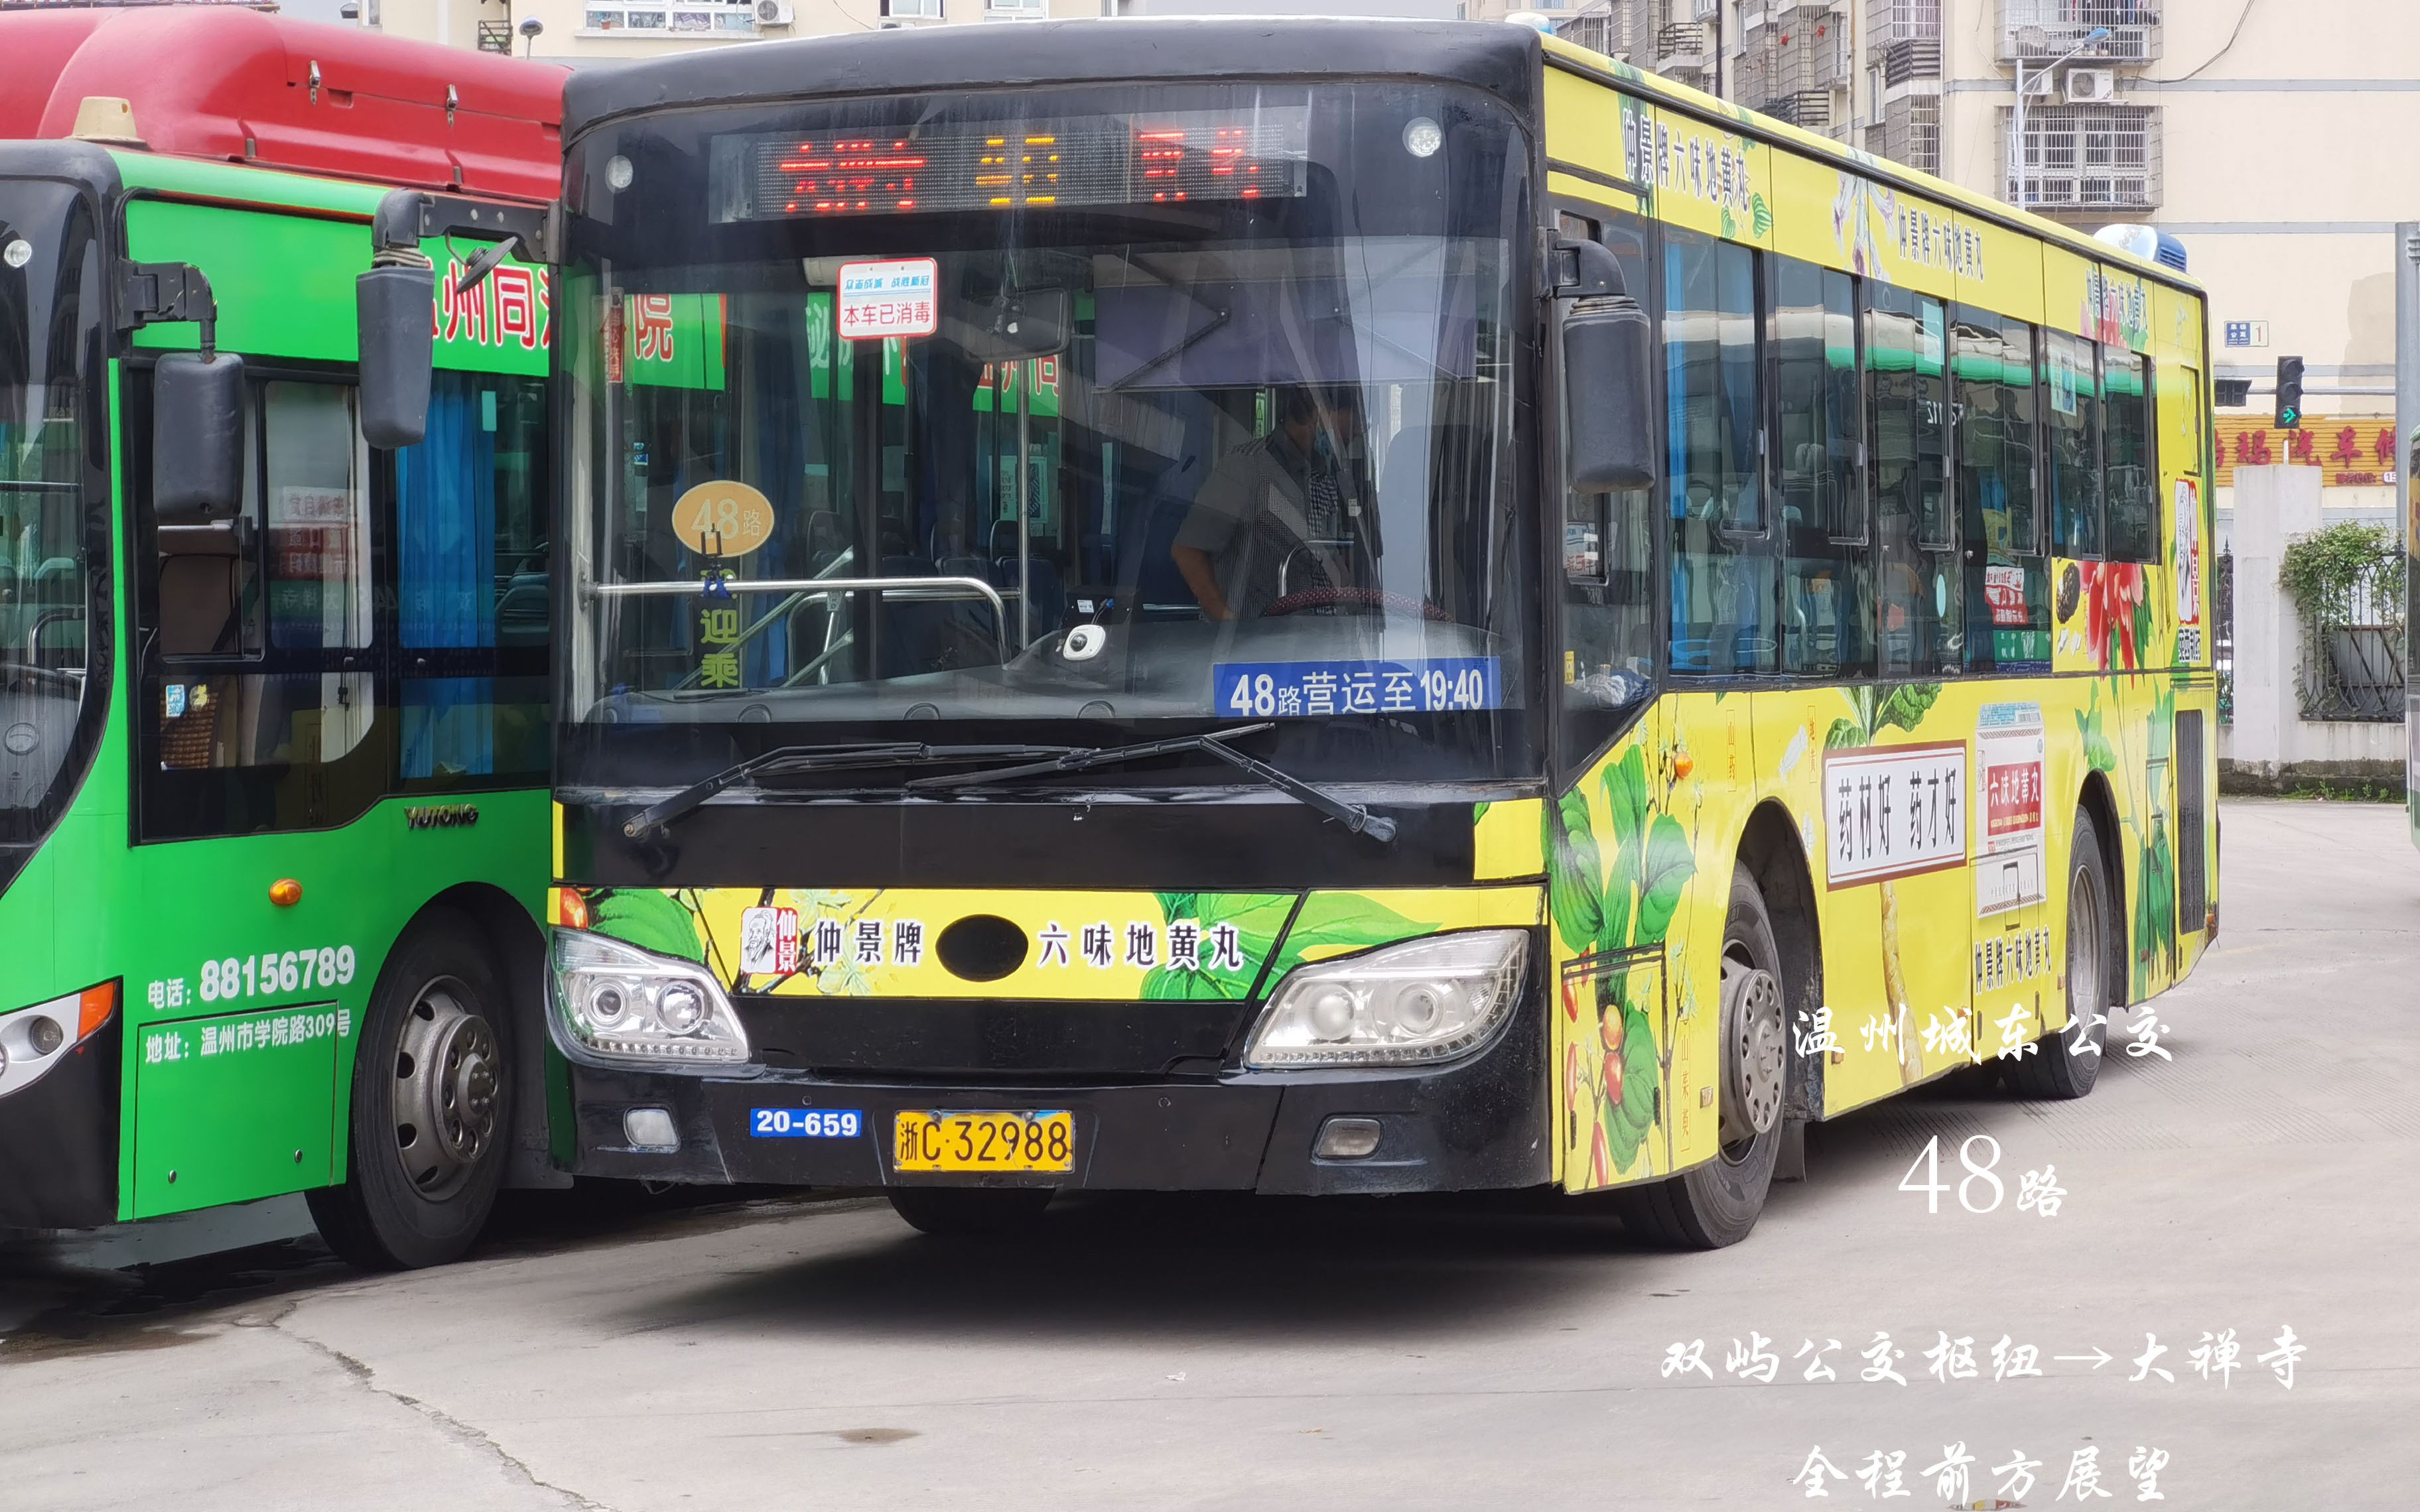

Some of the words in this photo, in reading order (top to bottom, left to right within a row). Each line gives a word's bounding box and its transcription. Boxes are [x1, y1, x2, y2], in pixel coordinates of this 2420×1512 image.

[1623, 108, 1749, 214] 仲景牌六味地黄丸
[1899, 202, 1984, 281] 仲景牌六味地黄丸
[843, 301, 931, 327] 本车已消毒
[2255, 324, 2261, 342] 1
[700, 568, 740, 688] 迎乘
[1838, 774, 1891, 863] 药材好
[1909, 767, 1956, 851] 药才好
[1990, 766, 2040, 807] 六味地黄丸
[776, 909, 797, 972] 仲景
[815, 920, 923, 964] 仲景牌
[1039, 922, 1241, 968] 六味地黄丸
[1975, 926, 2051, 994] 仲景牌六味地黄丸
[199, 944, 356, 1001] 88156789
[200, 1008, 352, 1057] 温州市学院路309号
[756, 1109, 858, 1137] 20-659
